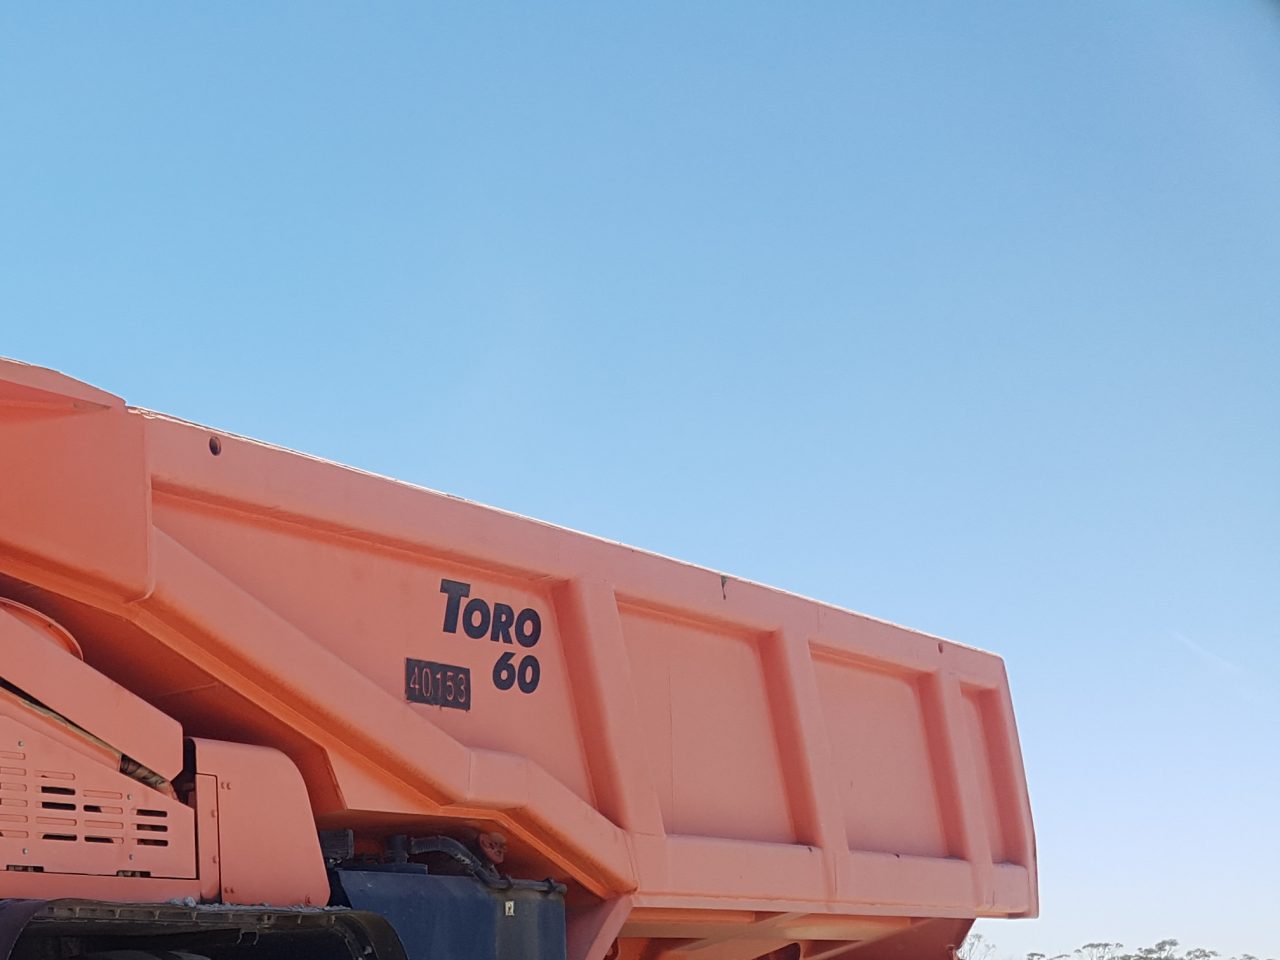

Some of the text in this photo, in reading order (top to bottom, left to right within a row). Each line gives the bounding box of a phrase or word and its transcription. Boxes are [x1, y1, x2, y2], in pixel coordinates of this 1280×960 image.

[440, 578, 541, 648] TORO
[409, 666, 467, 703] 40153
[492, 651, 541, 694] 60
